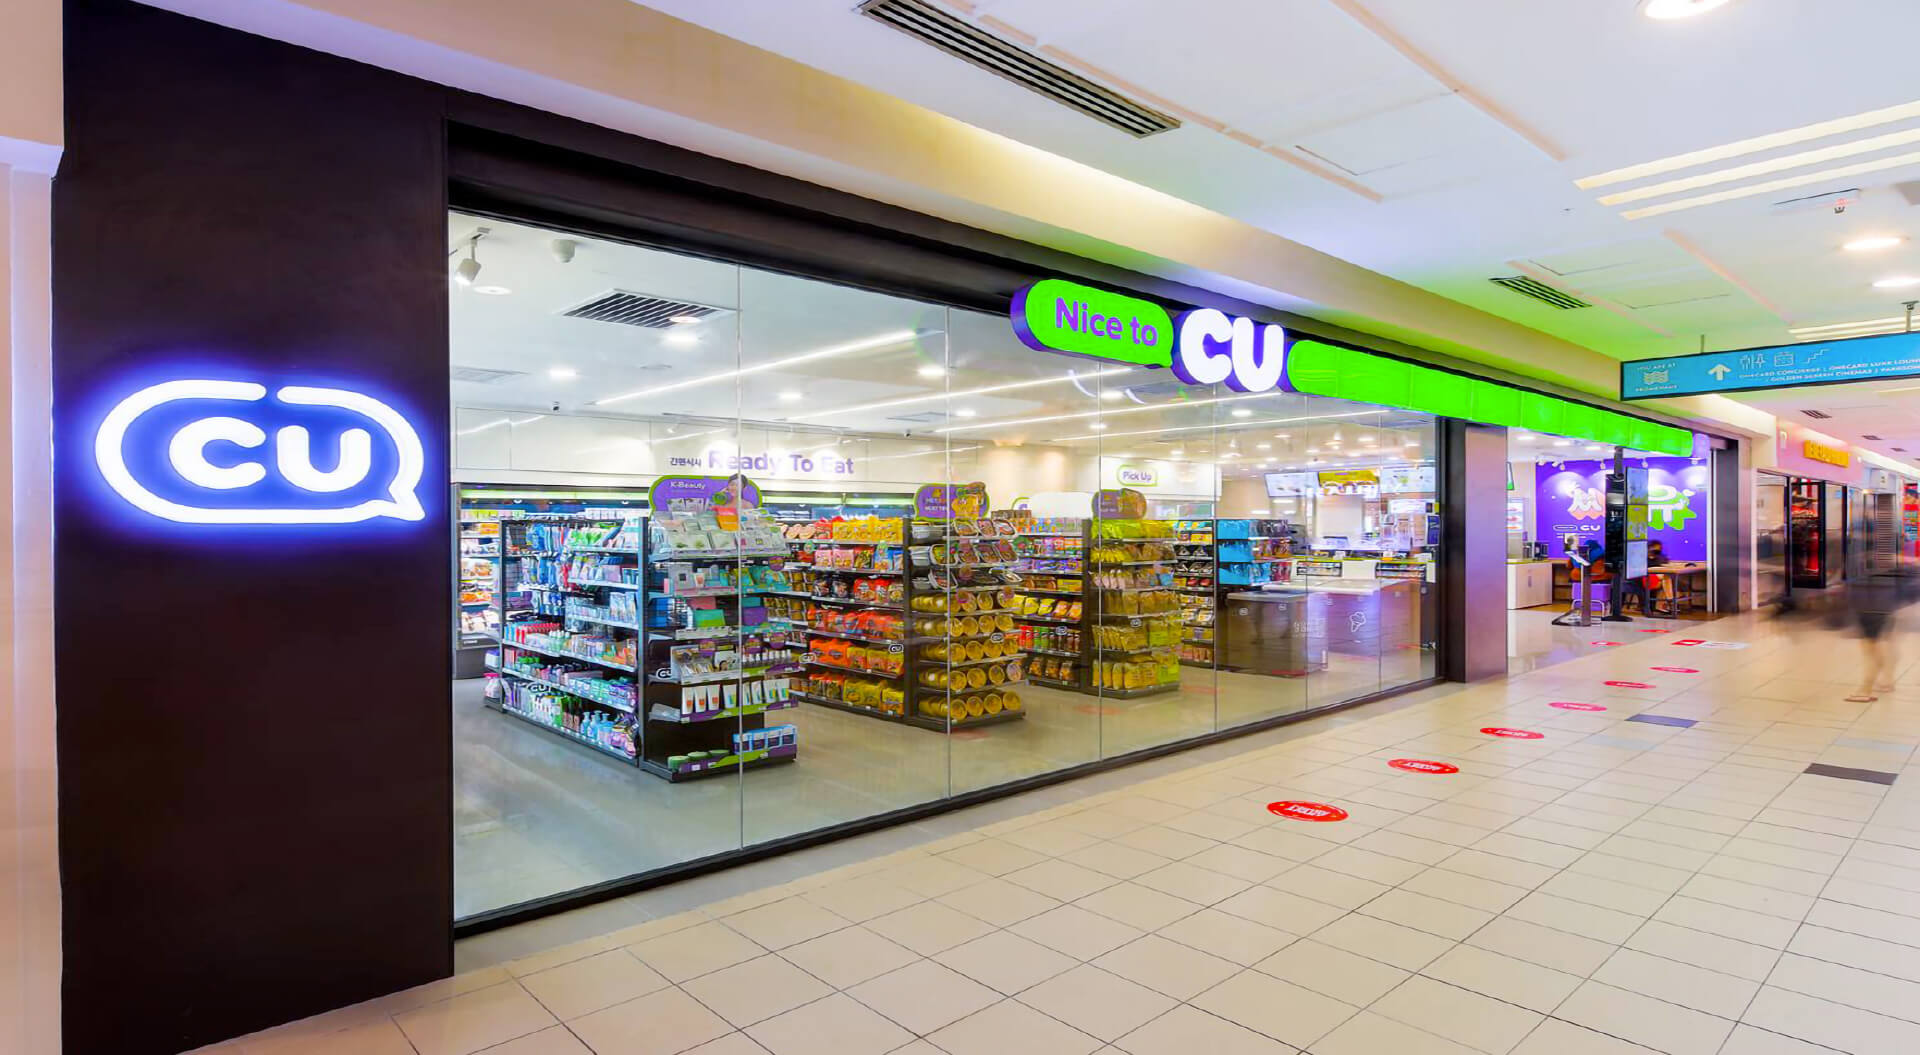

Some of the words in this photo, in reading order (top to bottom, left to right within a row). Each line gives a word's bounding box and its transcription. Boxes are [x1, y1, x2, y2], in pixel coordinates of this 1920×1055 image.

[1055, 297, 1123, 340] Nice
[1130, 316, 1158, 346] to
[1180, 308, 1285, 392] CU
[169, 416, 371, 492] CU
[708, 450, 779, 476] Ready
[789, 453, 814, 473] To
[821, 455, 855, 474] Eat
[1122, 471, 1139, 481] Pick
[1140, 472, 1153, 483] Up
